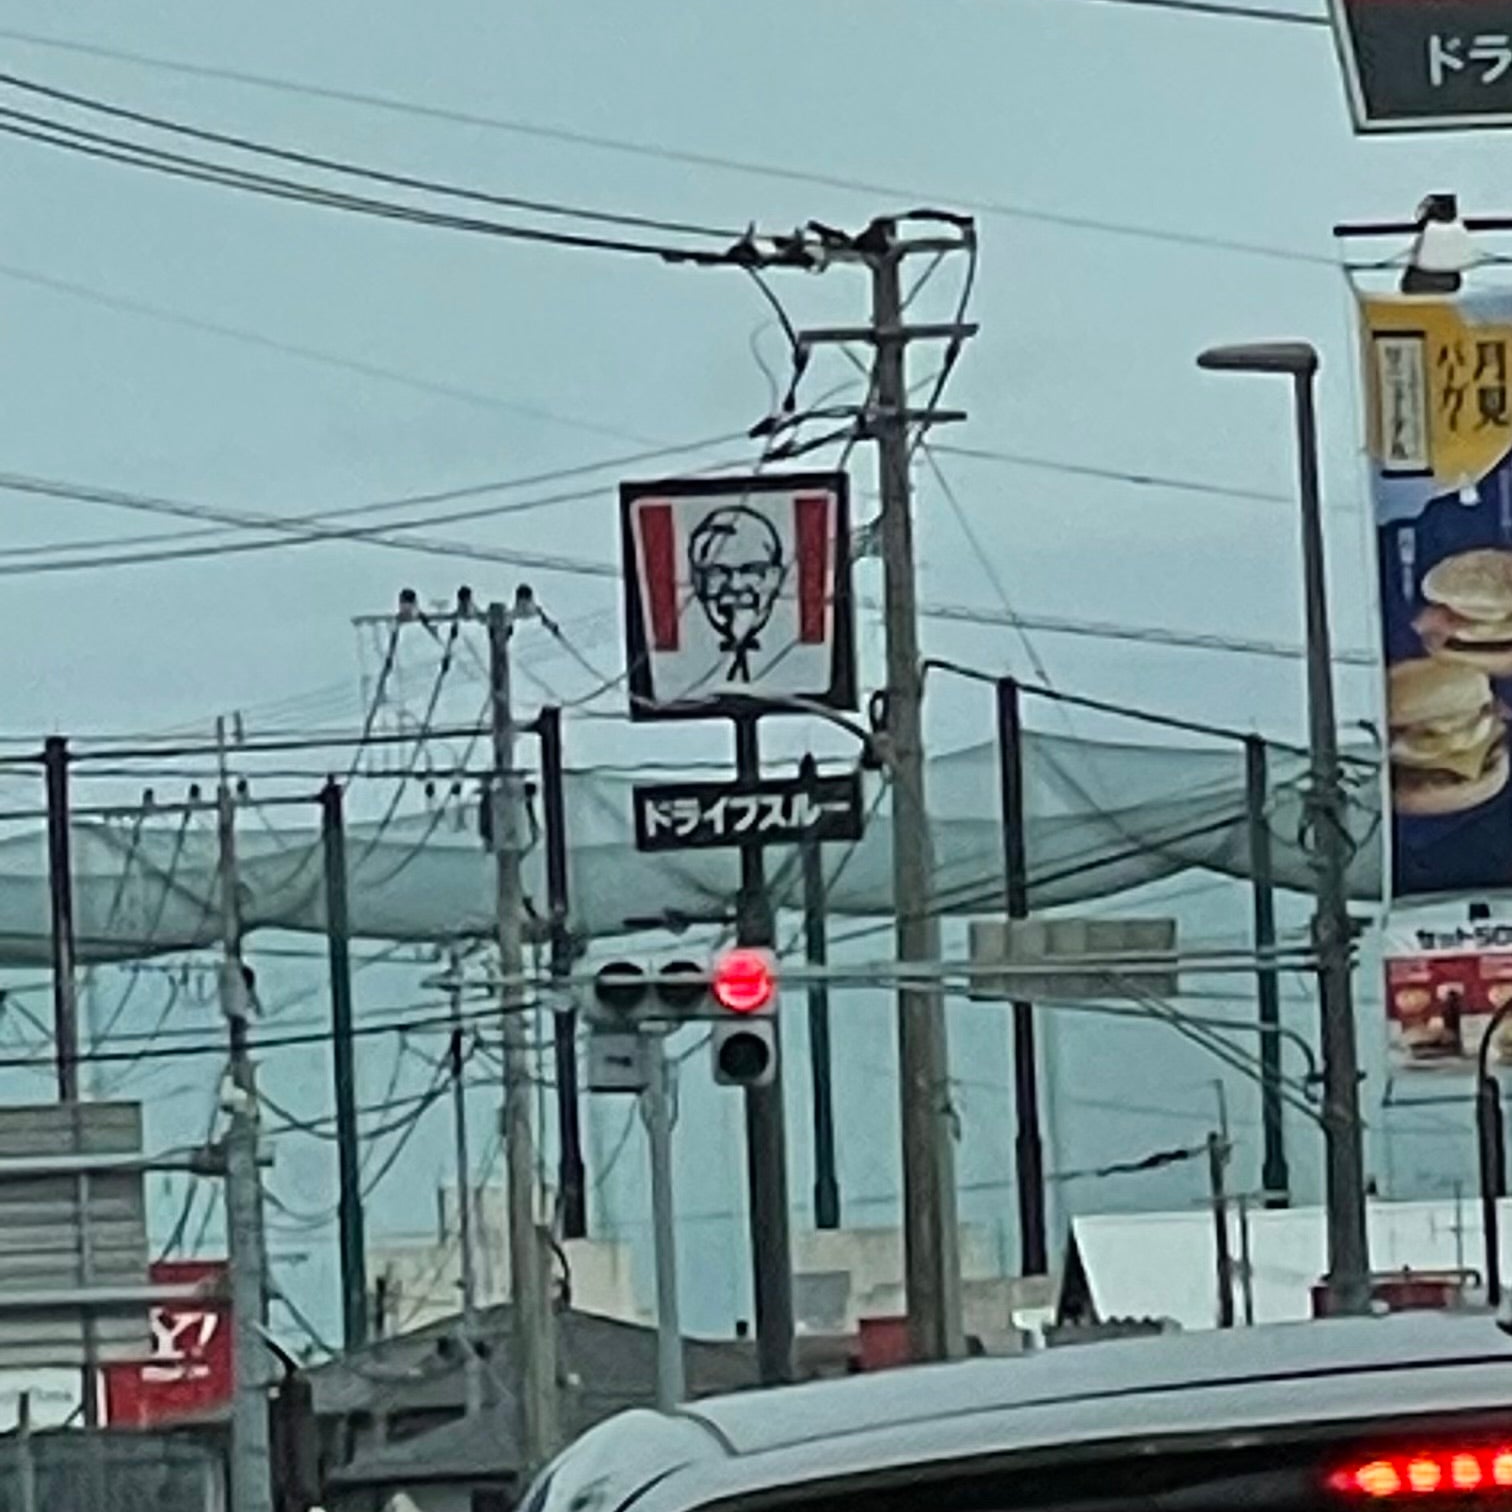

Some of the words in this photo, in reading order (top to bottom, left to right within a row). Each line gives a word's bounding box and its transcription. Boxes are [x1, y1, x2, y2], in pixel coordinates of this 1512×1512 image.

[1473, 340, 1510, 431] 月見
[645, 792, 850, 837] ドライブスルー
[149, 1306, 219, 1360] Y!
